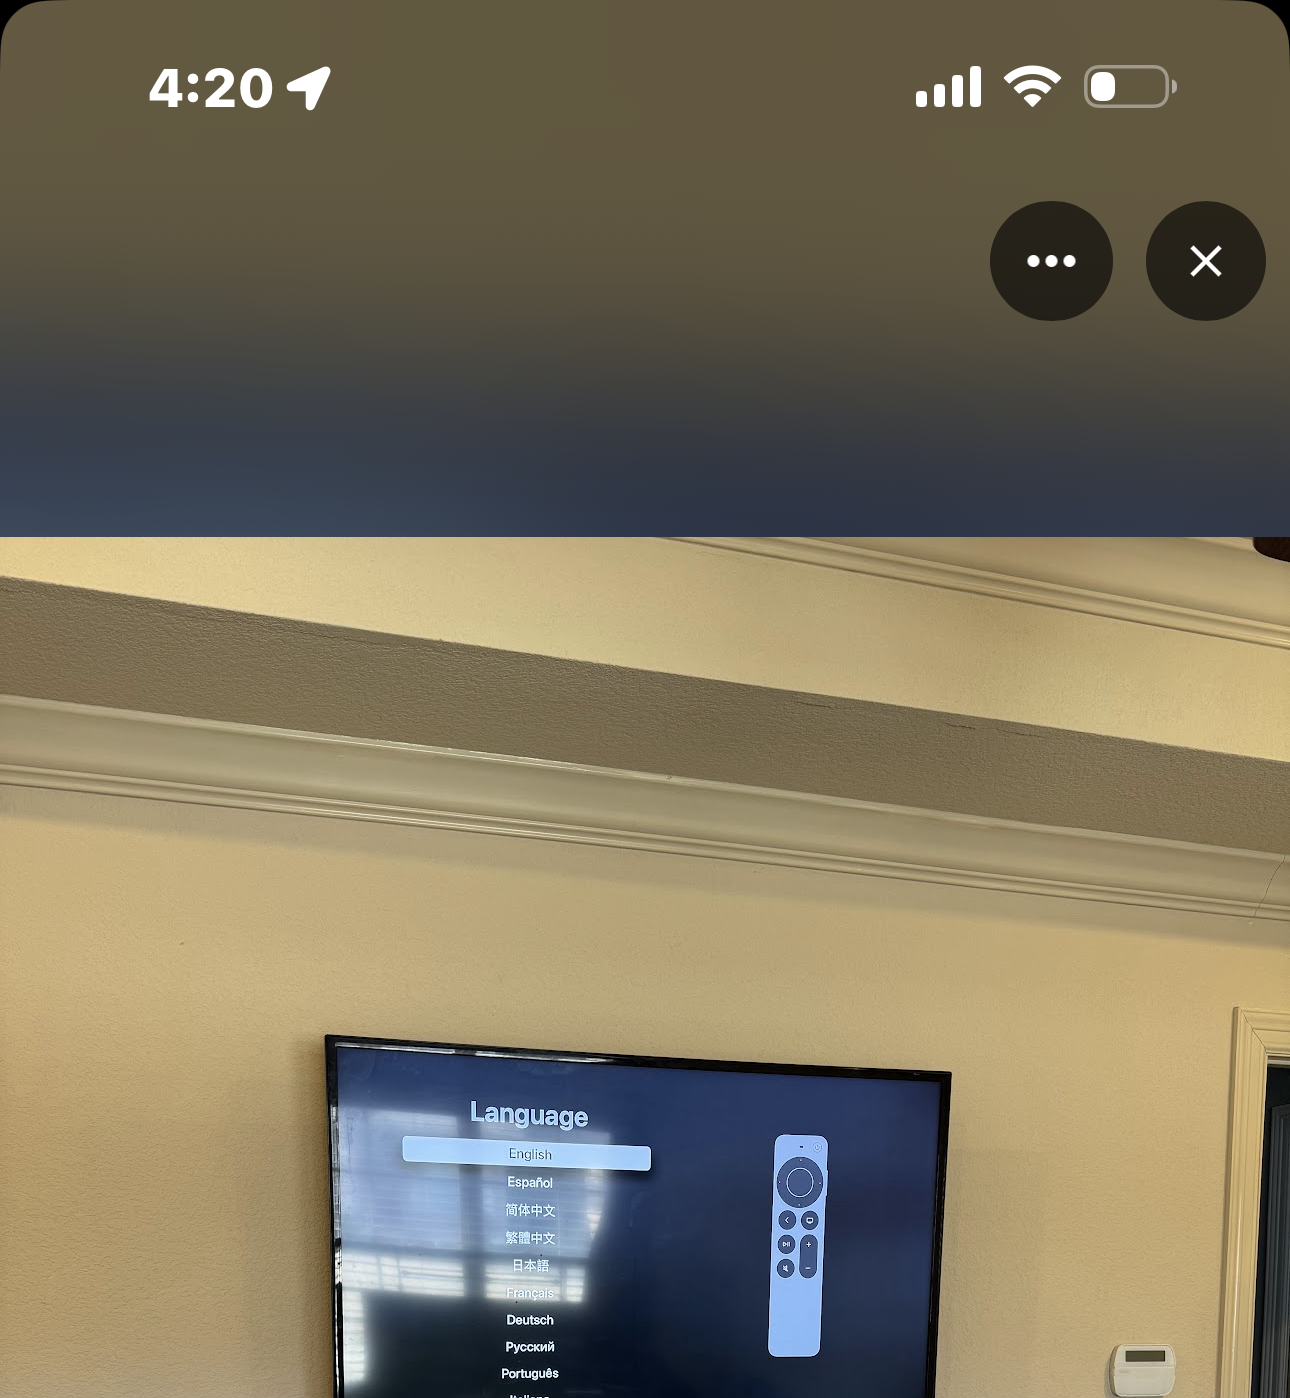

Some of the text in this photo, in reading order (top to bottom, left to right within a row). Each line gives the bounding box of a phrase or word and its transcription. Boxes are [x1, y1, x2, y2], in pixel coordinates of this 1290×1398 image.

[470, 1100, 589, 1131] Language
[508, 1147, 553, 1162] English
[507, 1175, 553, 1190] Español
[505, 1203, 556, 1218] 简体中文
[505, 1230, 556, 1245] 繁體中文
[512, 1258, 550, 1273] 日本語
[506, 1287, 554, 1301] Français
[506, 1314, 554, 1326] Deutsch
[505, 1340, 555, 1355] Русский
[501, 1367, 559, 1381] Português
